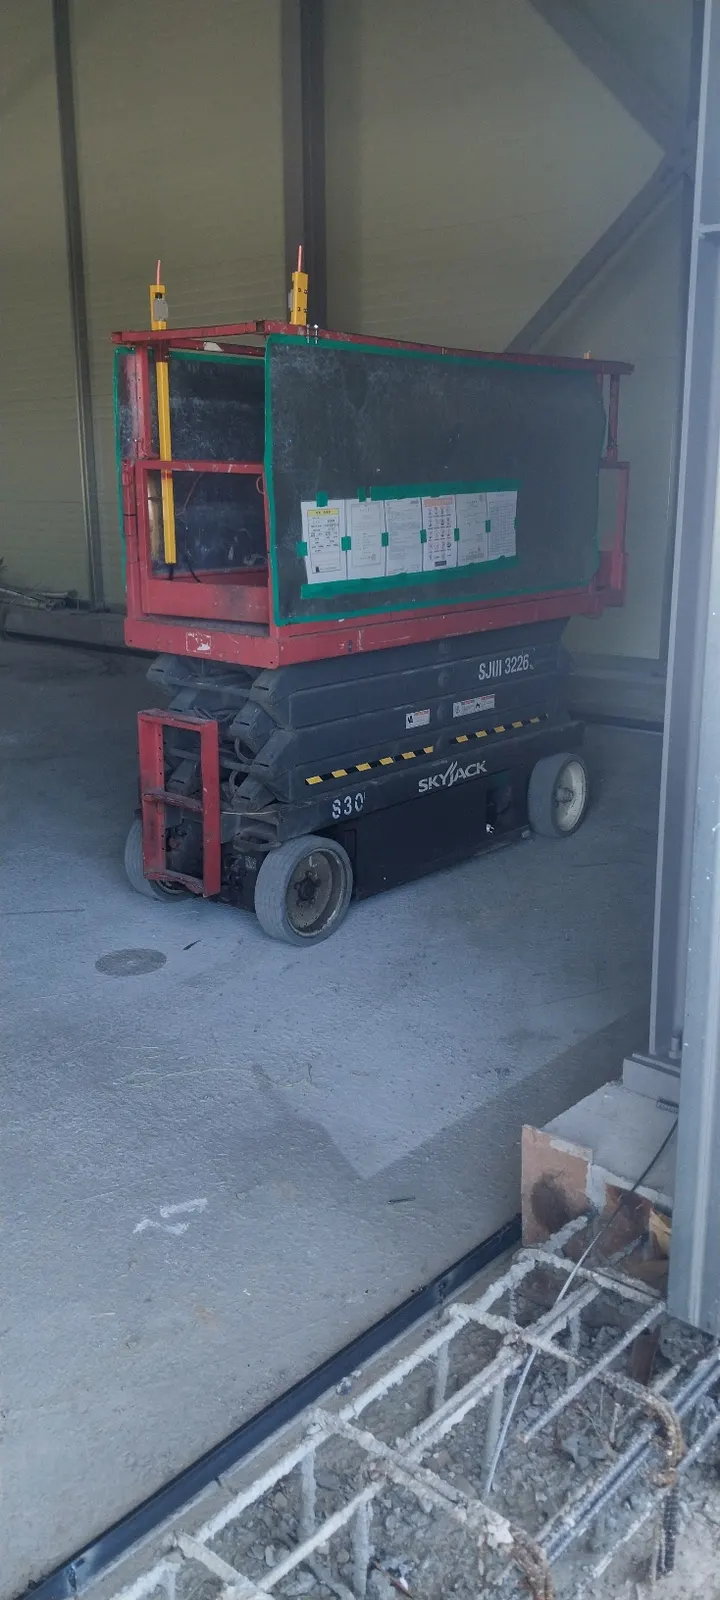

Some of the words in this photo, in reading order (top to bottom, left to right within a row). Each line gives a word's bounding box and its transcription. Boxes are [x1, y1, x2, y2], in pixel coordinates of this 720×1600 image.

[478, 659, 502, 680] SJIII
[504, 653, 530, 675] 3226
[418, 760, 488, 792] SKYJACK
